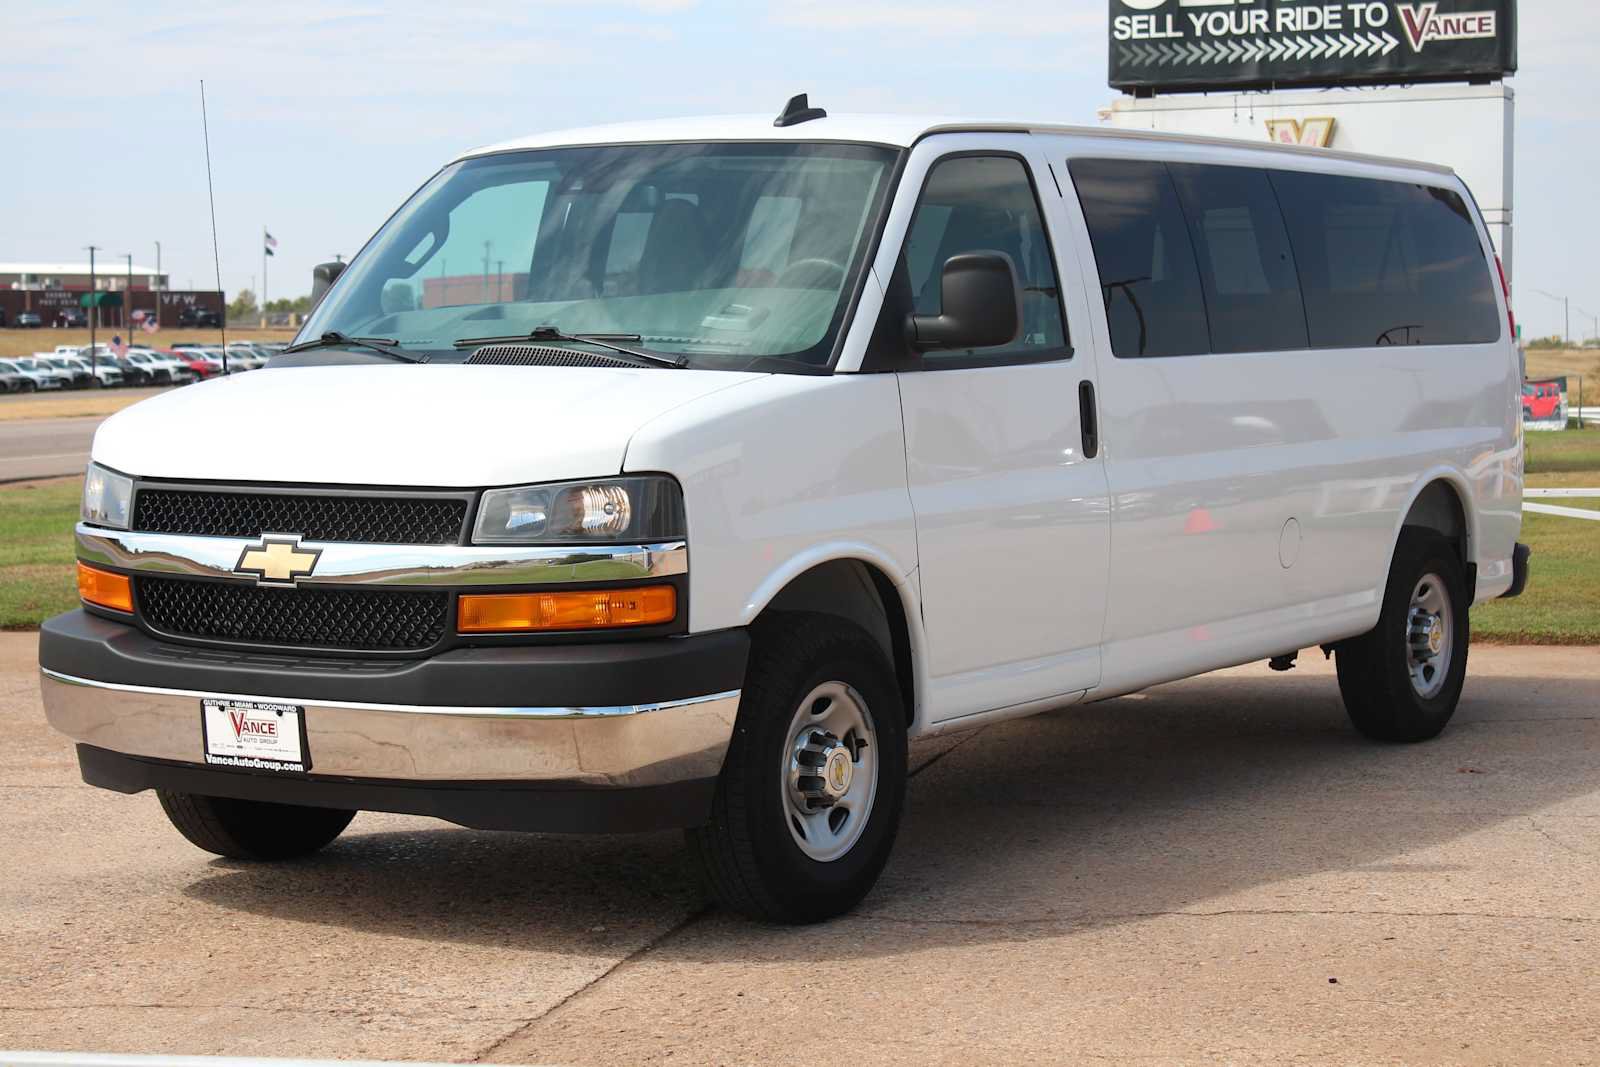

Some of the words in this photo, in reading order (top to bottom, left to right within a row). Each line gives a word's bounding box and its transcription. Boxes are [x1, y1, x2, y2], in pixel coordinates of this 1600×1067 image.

[1113, 14, 1184, 40] SELL
[1188, 8, 1271, 37] YOUR
[1276, 5, 1342, 33] RIDE
[1347, 2, 1389, 28] TO
[1397, 3, 1494, 52] VANCE
[162, 295, 196, 305] VFW
[203, 699, 230, 708] GUTHRIE
[257, 703, 296, 712] WOODWARD
[228, 709, 277, 740] VANCE
[205, 754, 304, 771] VanceAutoGroup.com
